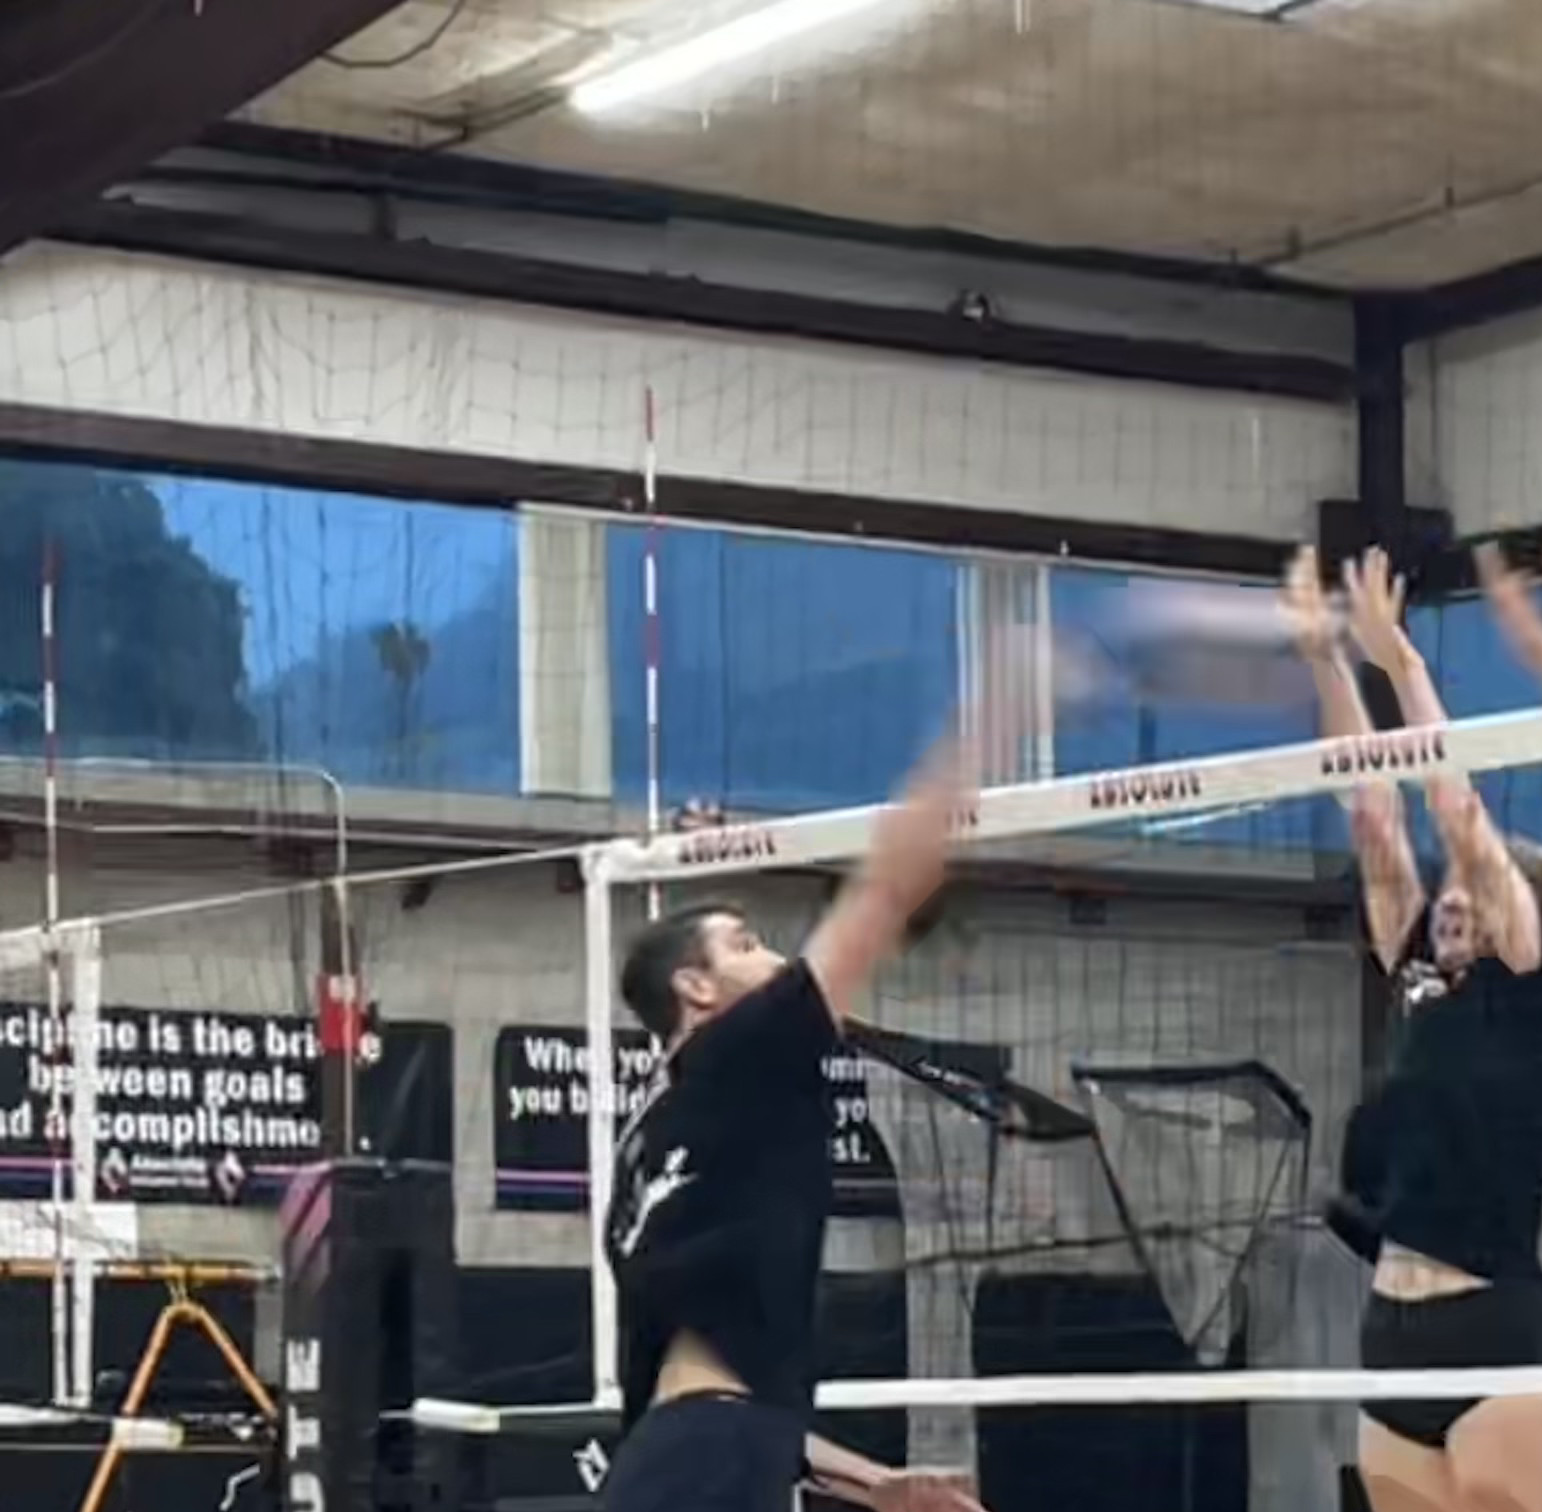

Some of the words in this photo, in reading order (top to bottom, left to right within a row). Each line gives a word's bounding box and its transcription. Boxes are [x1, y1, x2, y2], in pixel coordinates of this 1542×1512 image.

[149, 1014, 181, 1054] is
[193, 1016, 256, 1058] the
[265, 1021, 382, 1063] brie
[524, 1035, 590, 1073] Whe
[29, 1053, 193, 1100] beween
[203, 1064, 305, 1108] goals
[510, 1086, 562, 1121] you
